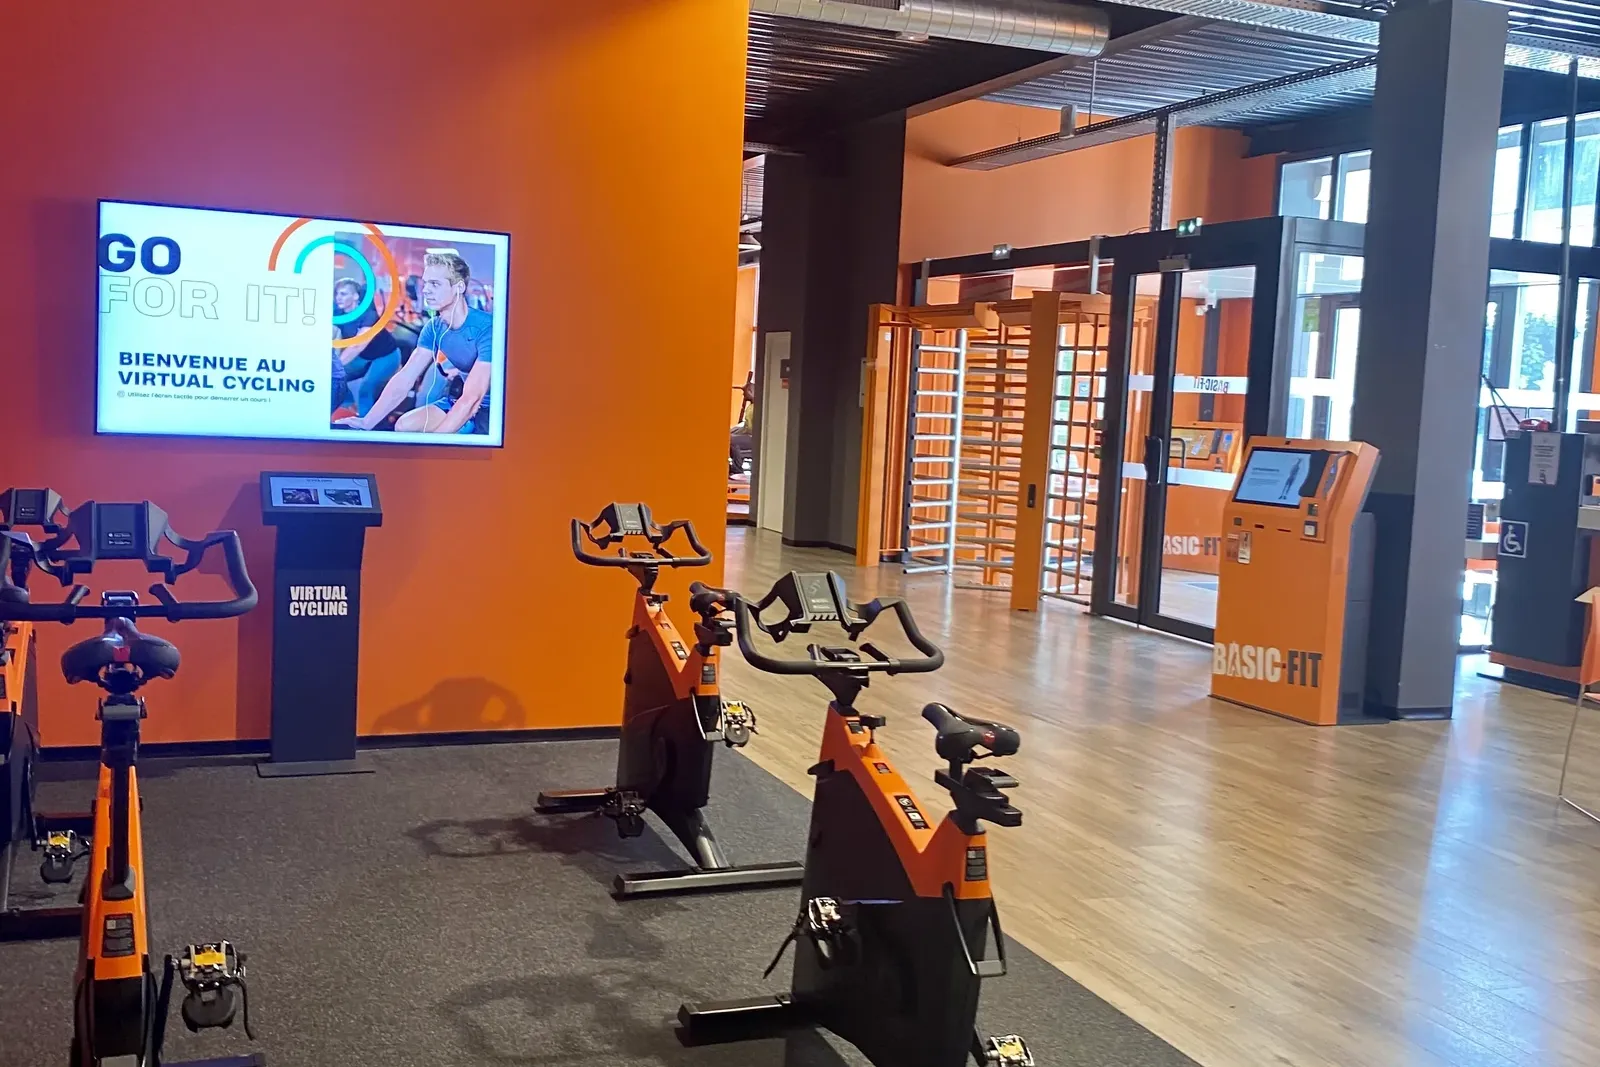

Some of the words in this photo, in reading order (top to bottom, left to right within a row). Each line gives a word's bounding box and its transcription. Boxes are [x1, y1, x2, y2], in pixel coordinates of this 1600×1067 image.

[99, 233, 181, 275] GO
[100, 275, 219, 319] FOR
[246, 284, 316, 326] IT!
[119, 352, 247, 371] BIENVENUE
[256, 358, 286, 373] AU
[118, 371, 214, 388] VIRTUAL
[222, 375, 315, 393] CYCLING
[1163, 535, 1221, 556] ASIC-FI
[290, 585, 348, 601] VIRTUAL
[289, 601, 348, 617] CYCLING
[1212, 641, 1323, 687] BASIC-FIT
